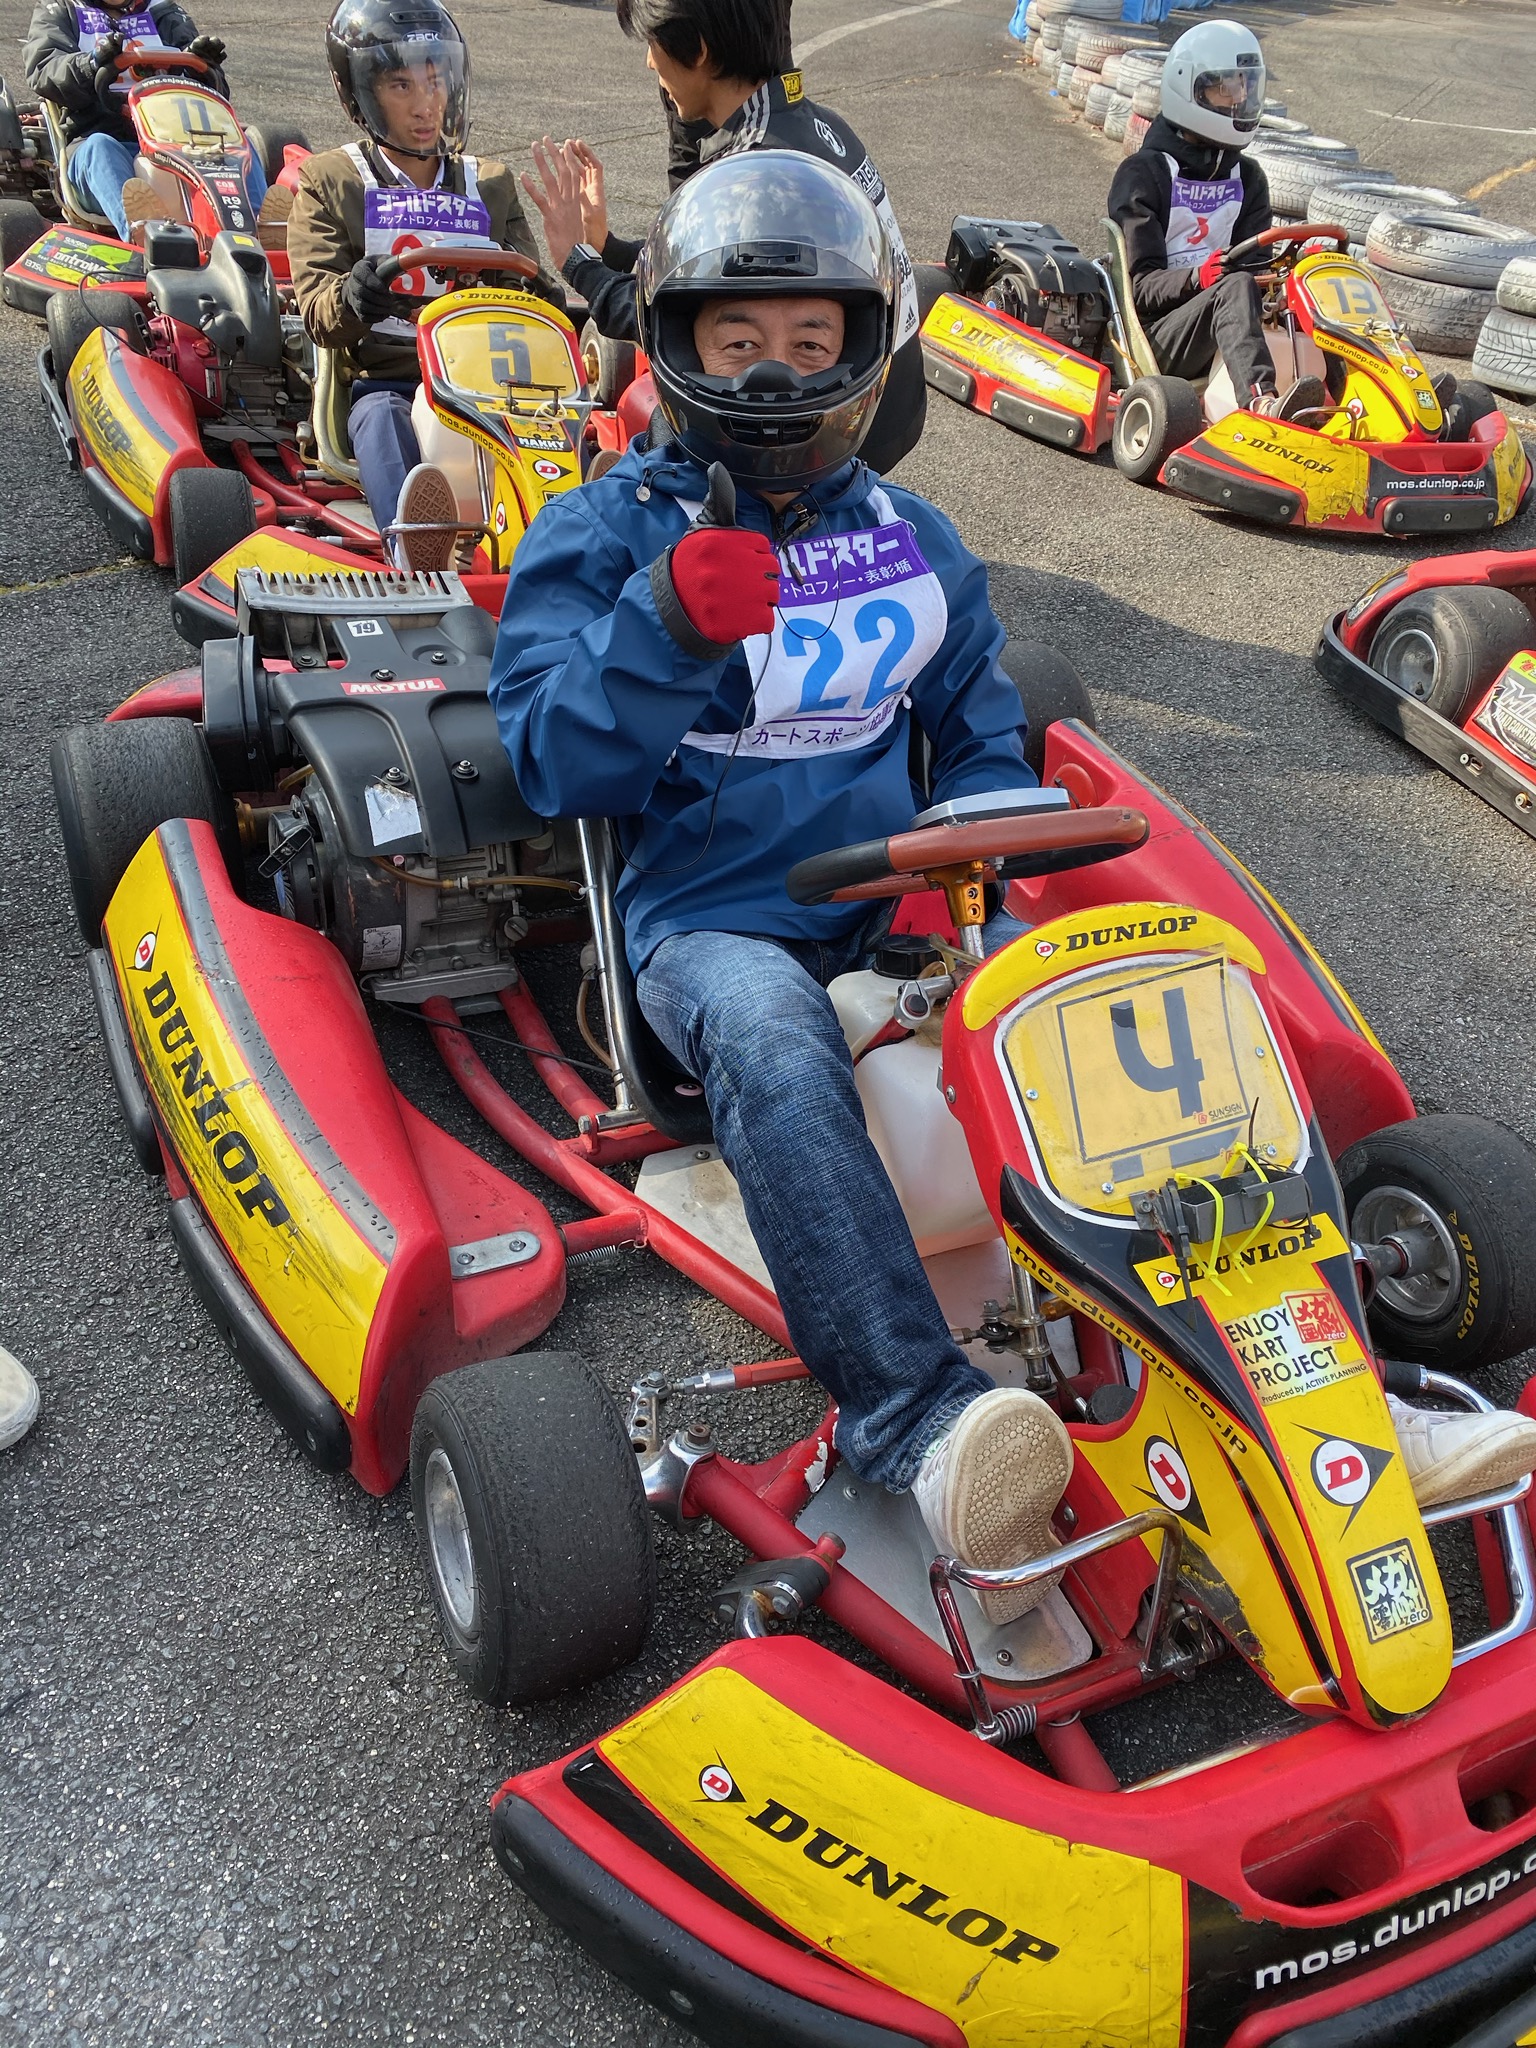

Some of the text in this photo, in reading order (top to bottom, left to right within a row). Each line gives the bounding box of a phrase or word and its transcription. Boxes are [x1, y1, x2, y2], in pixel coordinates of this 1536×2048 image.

[171, 97, 212, 134] 11
[221, 196, 241, 205] R9
[376, 193, 480, 217] ゴールドスター
[467, 293, 538, 304] DUNLOP
[1327, 278, 1378, 315] 13
[487, 321, 532, 386] 5
[1316, 334, 1389, 375] mos.dunlop.co.jp
[438, 411, 515, 469] mos.dunlop.co.jp
[1247, 437, 1335, 475] DUNLOP
[1386, 477, 1486, 491] mos.dunlop.co.jp
[352, 621, 376, 635] 19
[781, 598, 915, 716] 22
[349, 679, 440, 693] MOTUL
[1066, 915, 1198, 952] DUNLOP
[1110, 986, 1205, 1119] 4
[143, 970, 291, 1228] DUNLOP
[1457, 1231, 1475, 1340] DUNLOP
[1224, 1308, 1291, 1344] ENJOY
[1014, 1245, 1248, 1454] mos.dunlop.co.jp
[1236, 1335, 1288, 1367] KART
[1249, 1345, 1338, 1391] PROJECT
[1261, 1363, 1368, 1404] Produced by ACTIVE PLANNING
[745, 1797, 1061, 1965] DUNLOP
